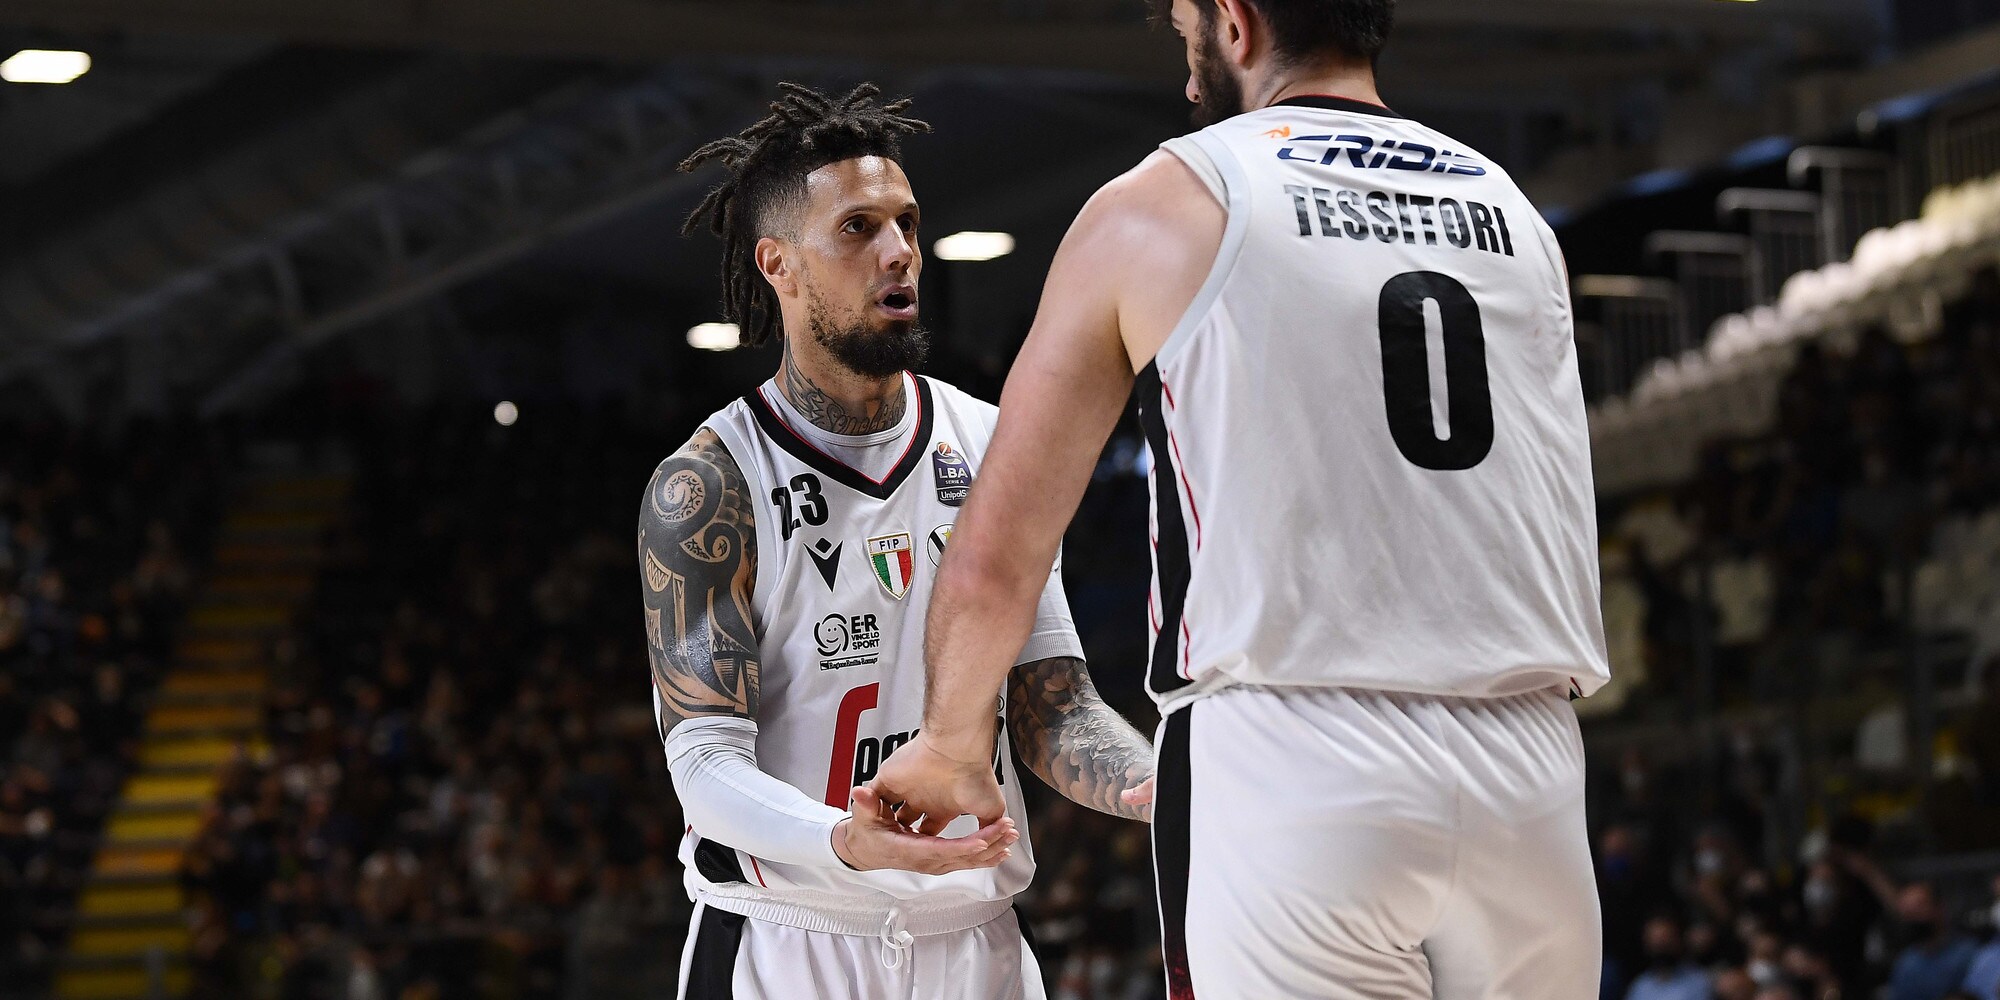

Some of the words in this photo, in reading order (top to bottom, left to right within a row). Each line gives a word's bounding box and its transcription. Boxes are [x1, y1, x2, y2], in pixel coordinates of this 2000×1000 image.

[1284, 184, 1515, 257] TESSITORI
[1378, 270, 1495, 471] 0
[938, 467, 969, 479] LBA
[940, 489, 968, 500] UnipolS
[771, 472, 829, 542] 23
[879, 538, 900, 551] FIP
[850, 632, 870, 641] VINCE
[870, 631, 880, 639] LO
[852, 639, 880, 650] SPORT
